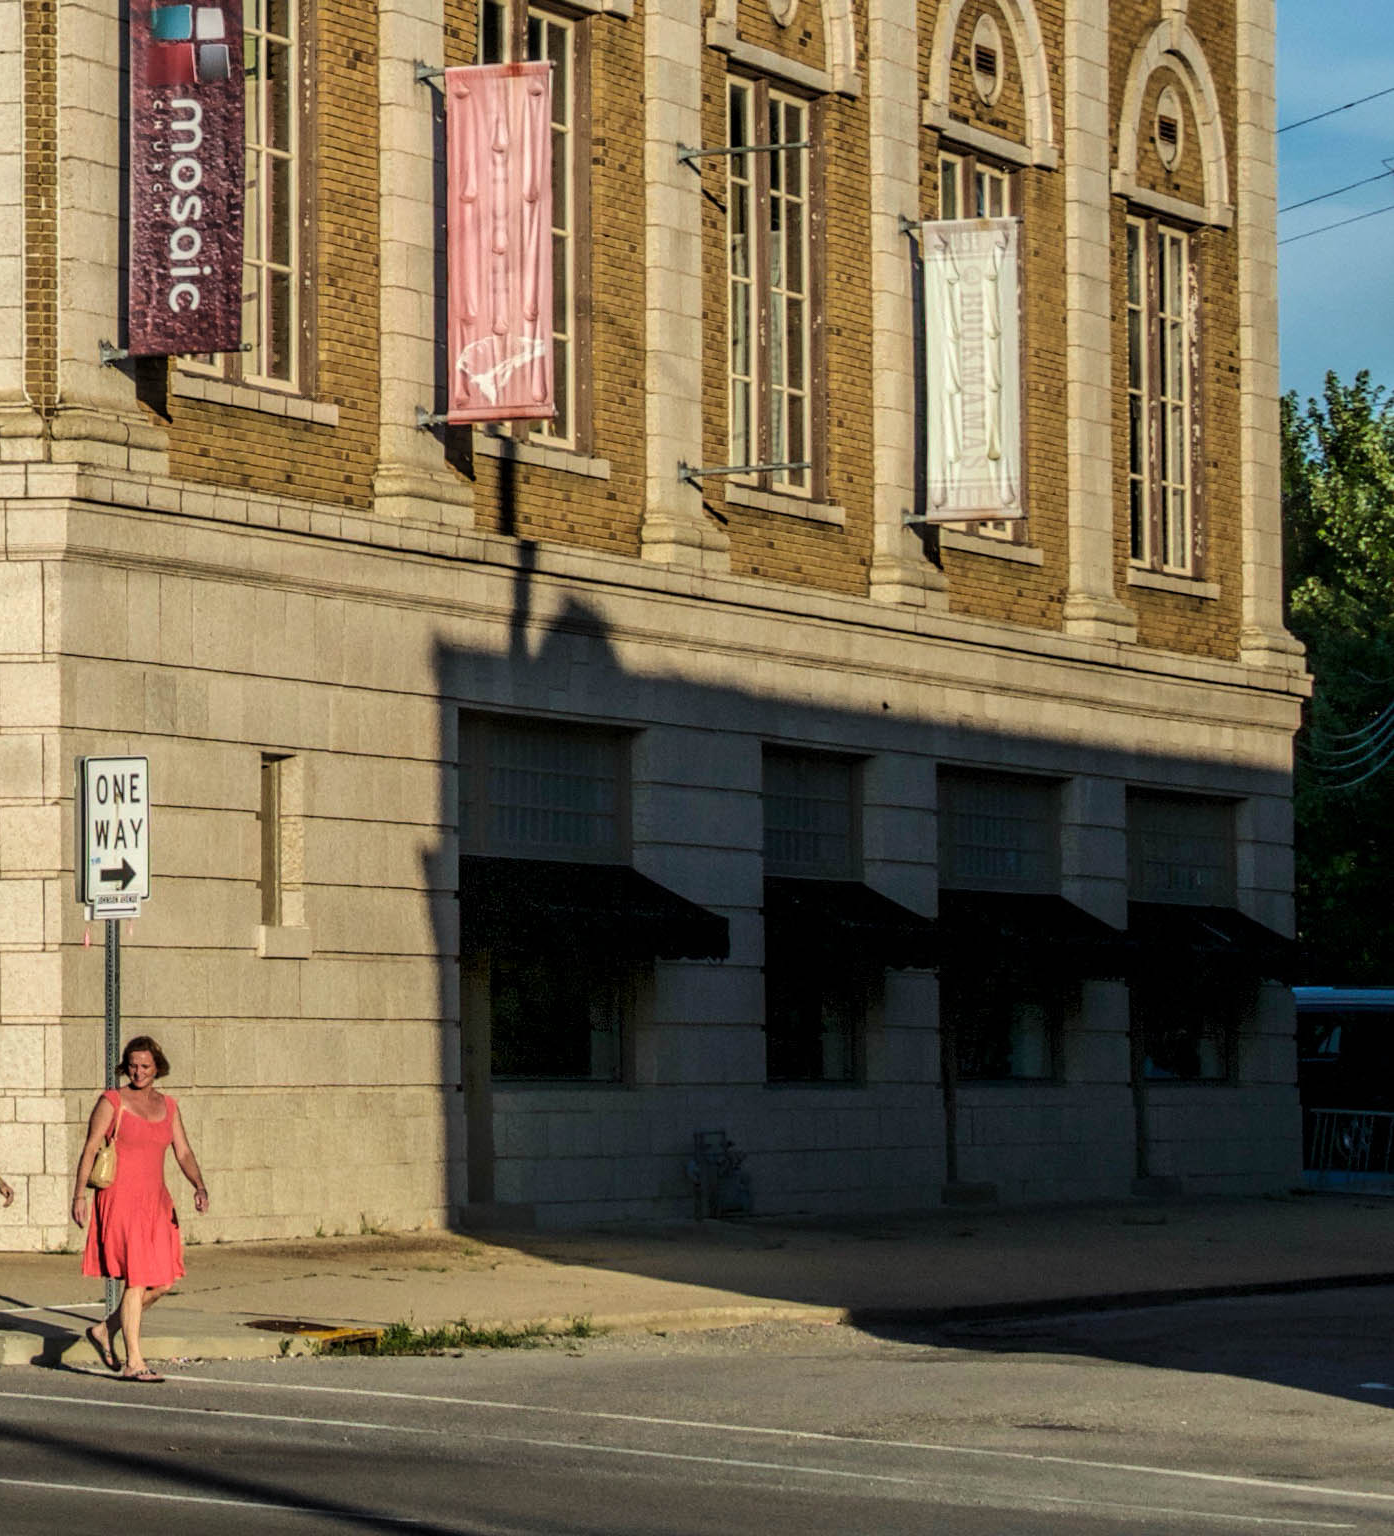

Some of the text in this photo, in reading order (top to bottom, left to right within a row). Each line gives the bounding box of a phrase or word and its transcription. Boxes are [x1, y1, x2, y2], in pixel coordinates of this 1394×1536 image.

[152, 100, 164, 214] CHURCH
[168, 98, 212, 313] mosaic
[96, 773, 141, 806] ONE
[95, 818, 143, 850] WAY
